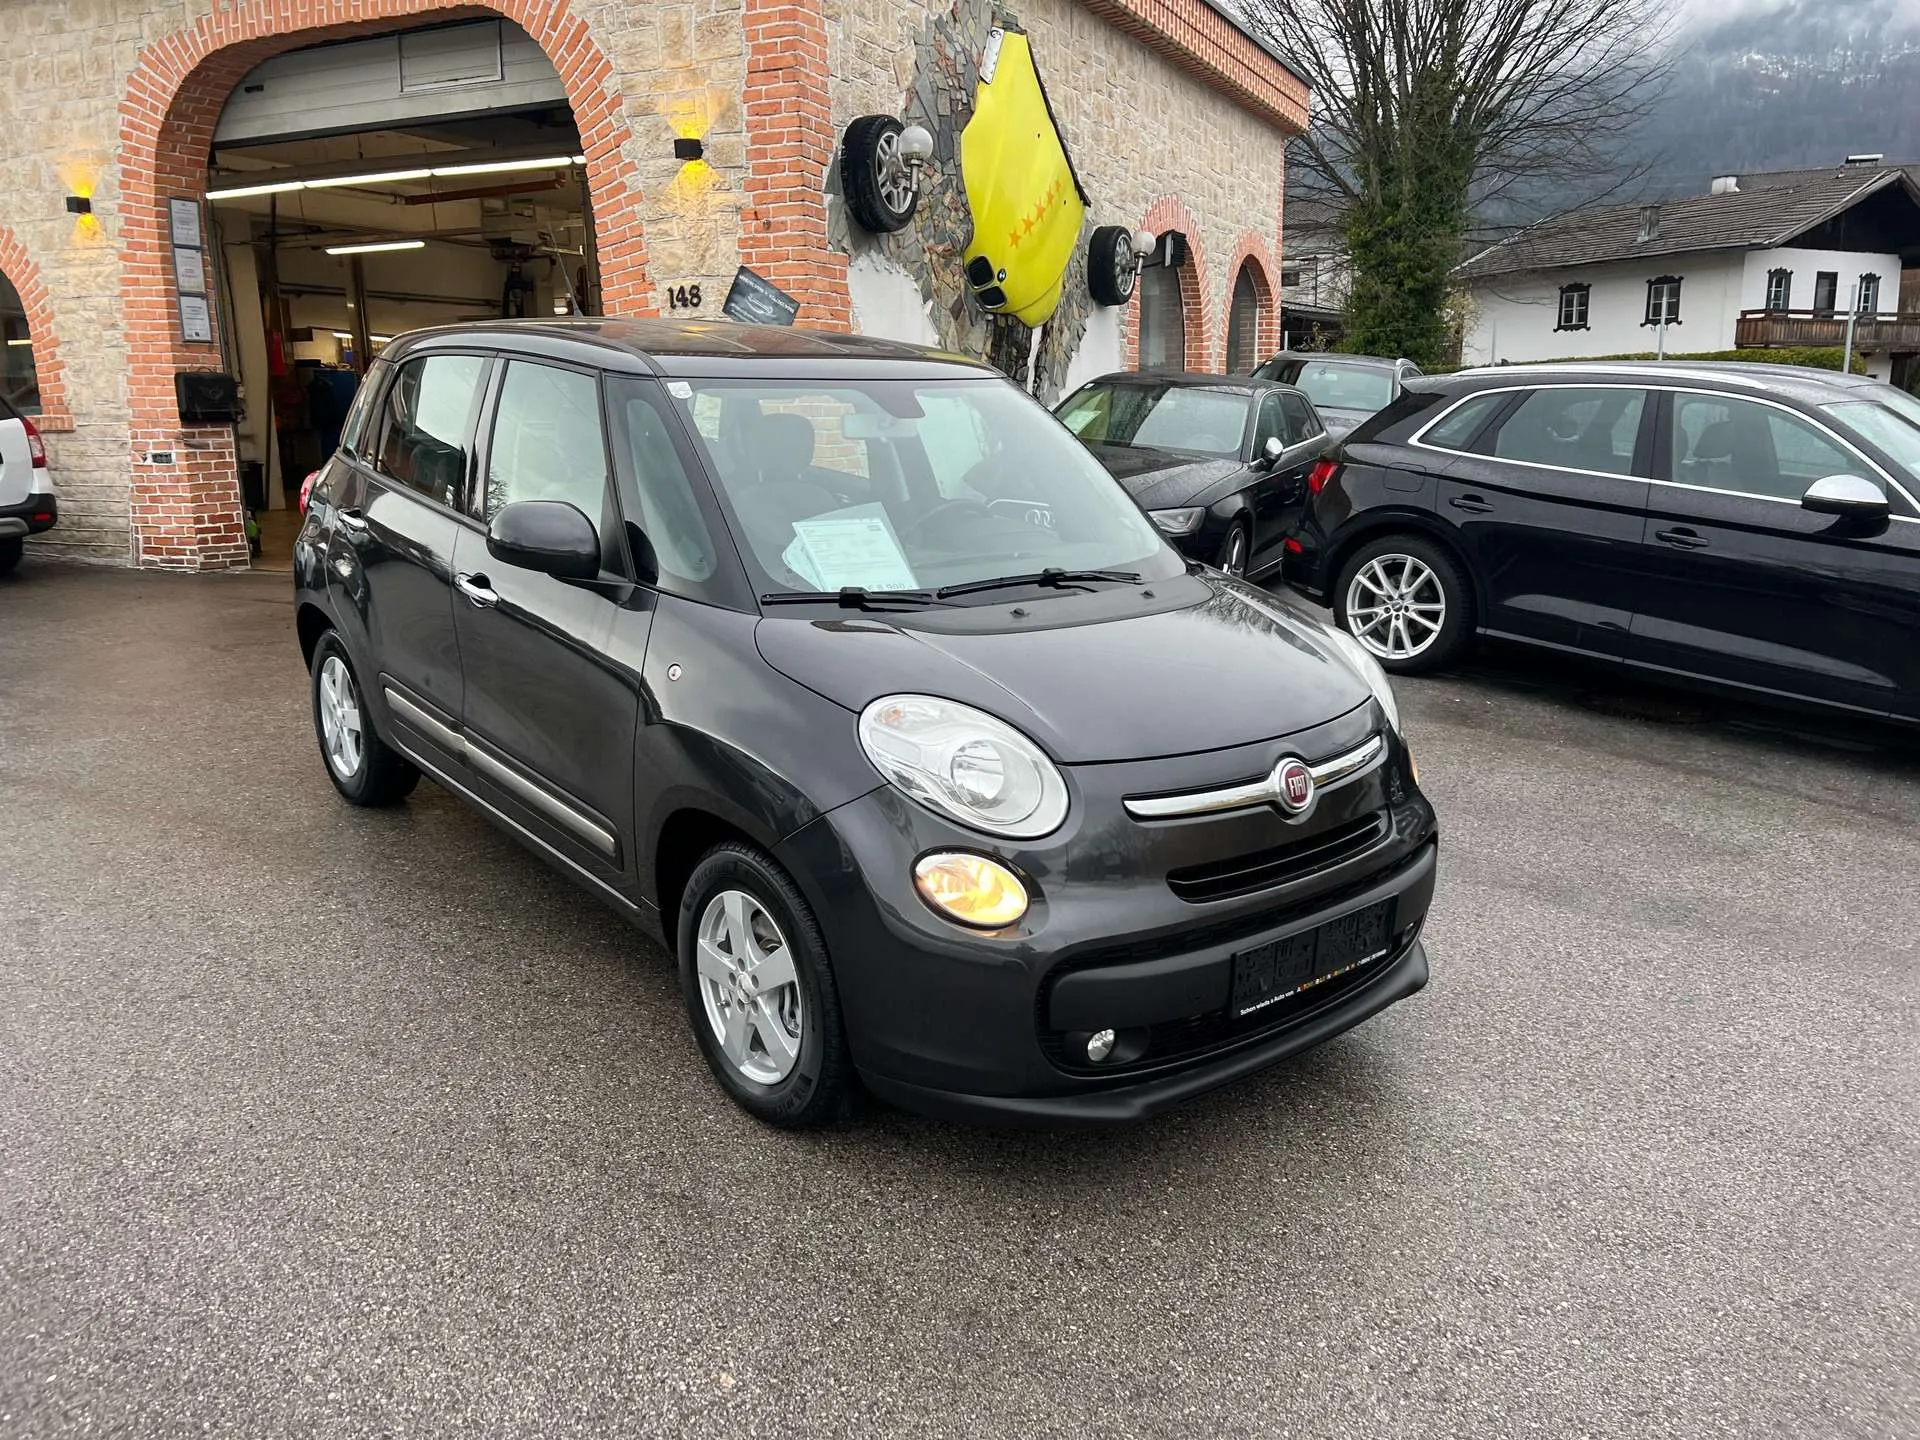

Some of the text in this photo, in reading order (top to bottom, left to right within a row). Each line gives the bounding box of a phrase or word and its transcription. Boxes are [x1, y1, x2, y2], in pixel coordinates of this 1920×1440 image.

[667, 285, 702, 309] 148
[1288, 775, 1306, 797] FIAT
[1240, 1006, 1256, 1015] Schon
[1274, 994, 1285, 1002] Auto
